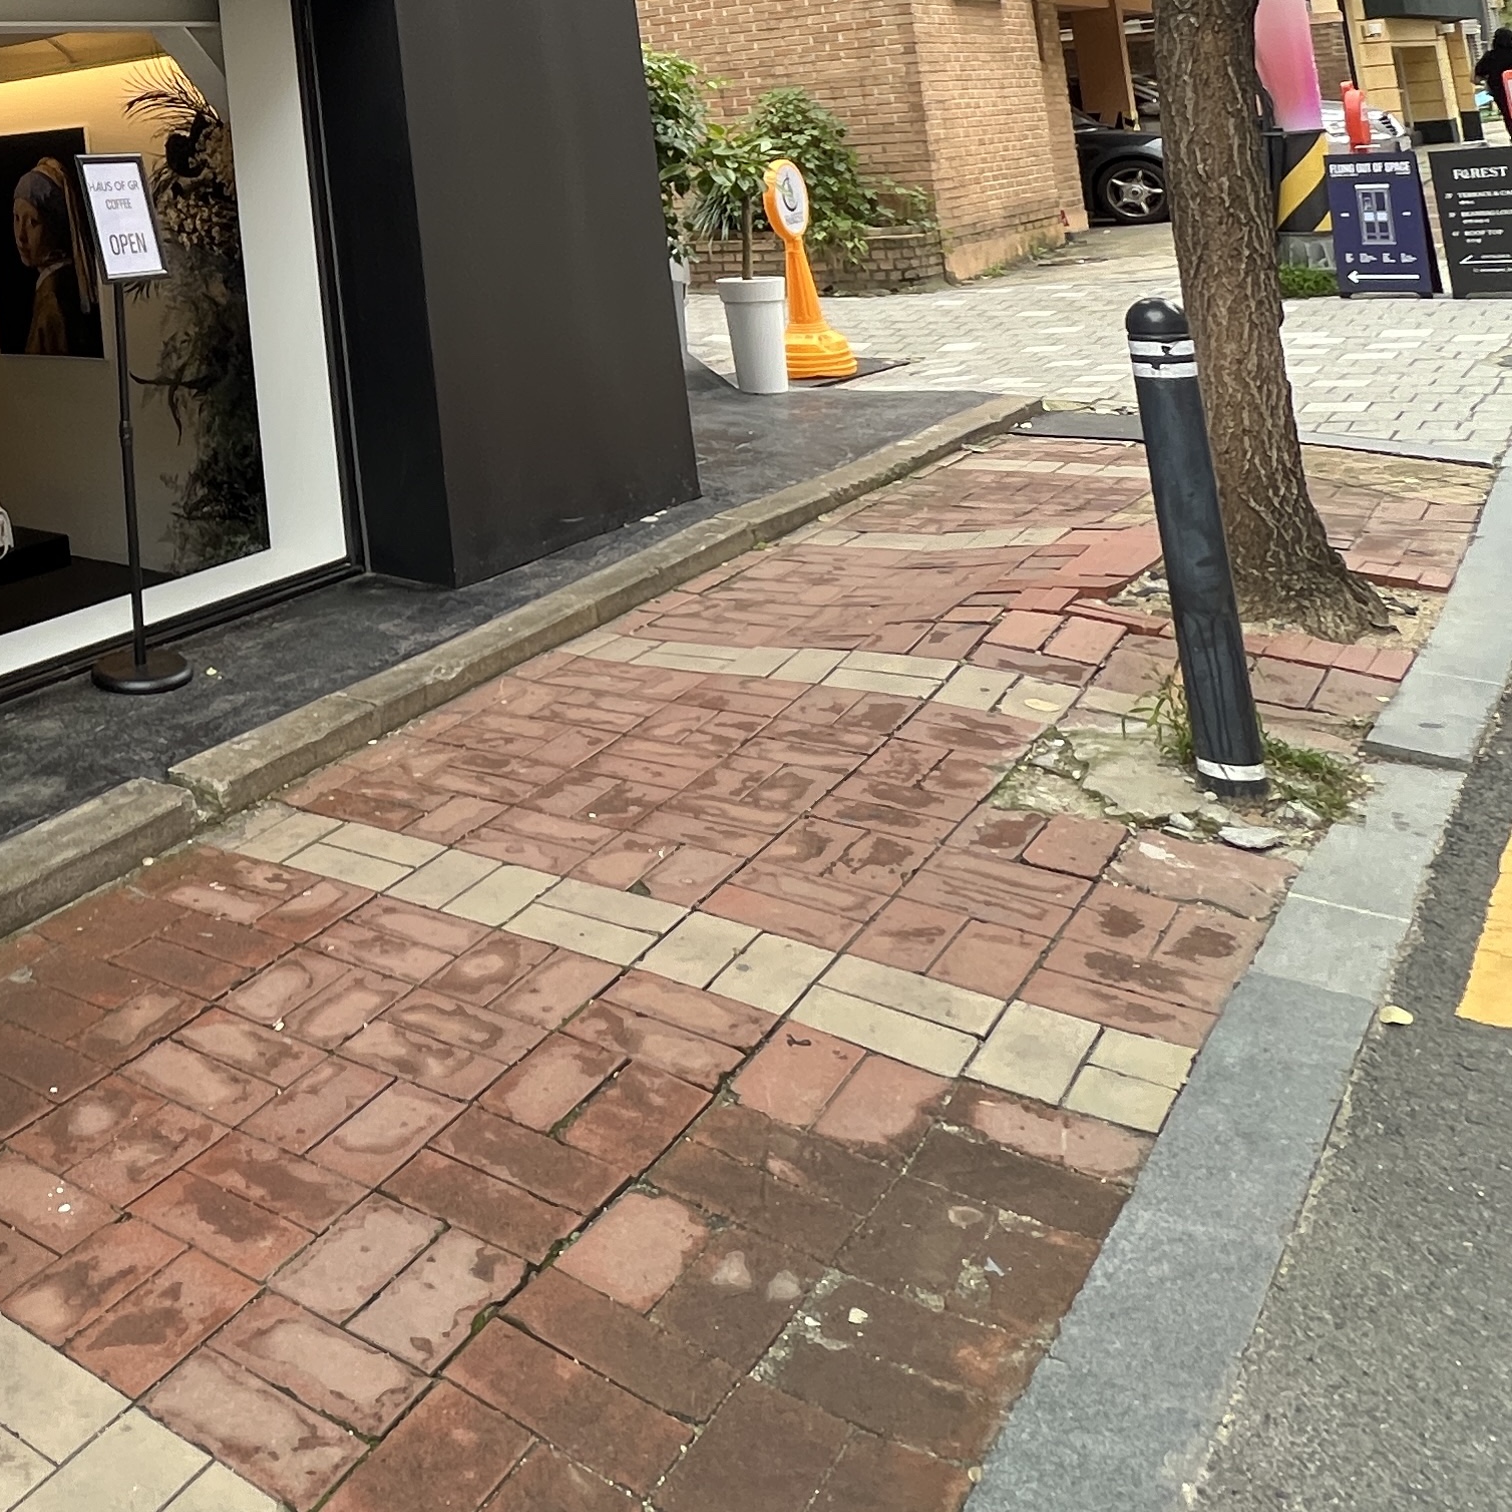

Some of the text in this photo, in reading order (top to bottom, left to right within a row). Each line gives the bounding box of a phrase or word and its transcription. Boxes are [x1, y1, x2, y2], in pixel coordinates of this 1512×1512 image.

[1453, 166, 1508, 179] FOREST
[88, 180, 139, 192] HAUS OF GR
[106, 199, 133, 210] COFFEE
[109, 233, 148, 255] OPEN
